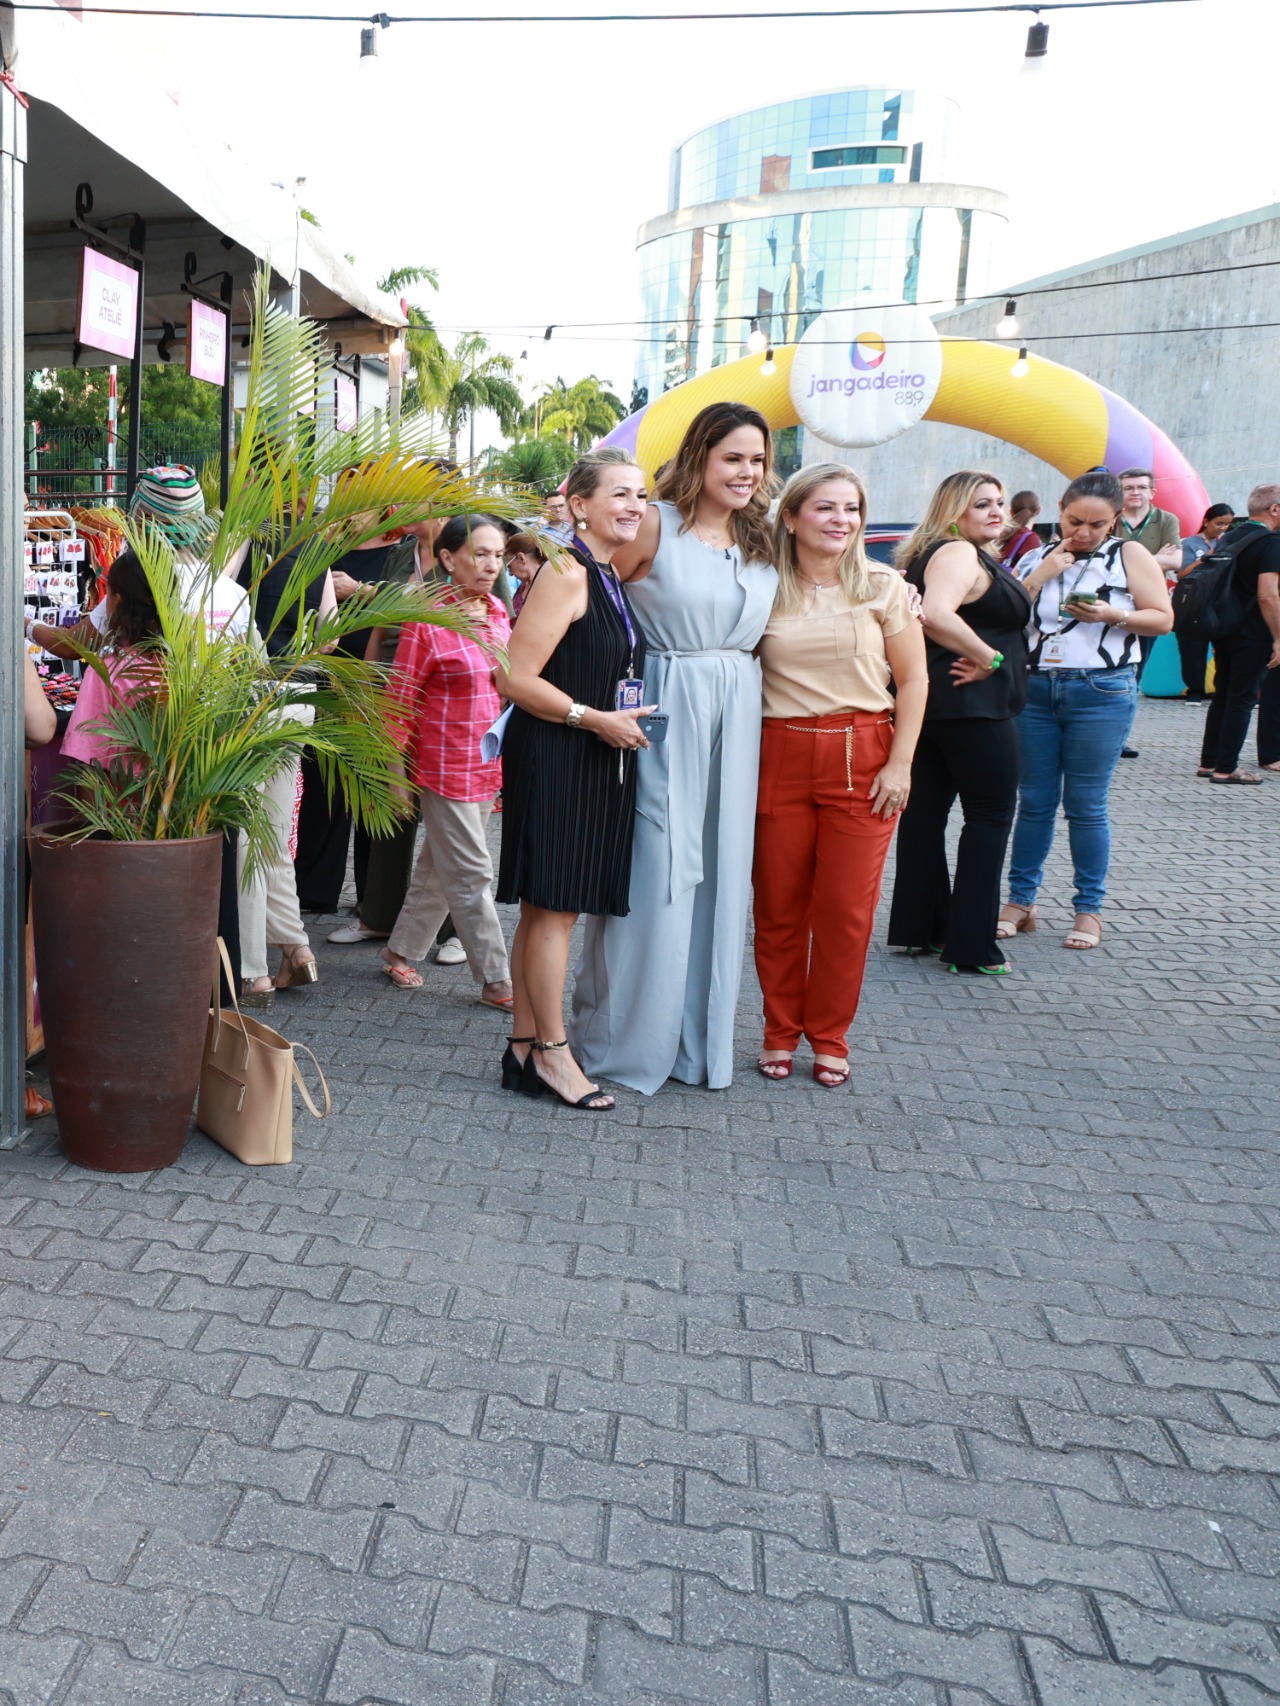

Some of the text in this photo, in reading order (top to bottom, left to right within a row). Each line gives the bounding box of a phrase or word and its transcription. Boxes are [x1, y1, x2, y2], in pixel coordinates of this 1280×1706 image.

[101, 287, 121, 307] CLAY
[807, 369, 926, 398] jangadeiro
[894, 390, 925, 407] 88,9
